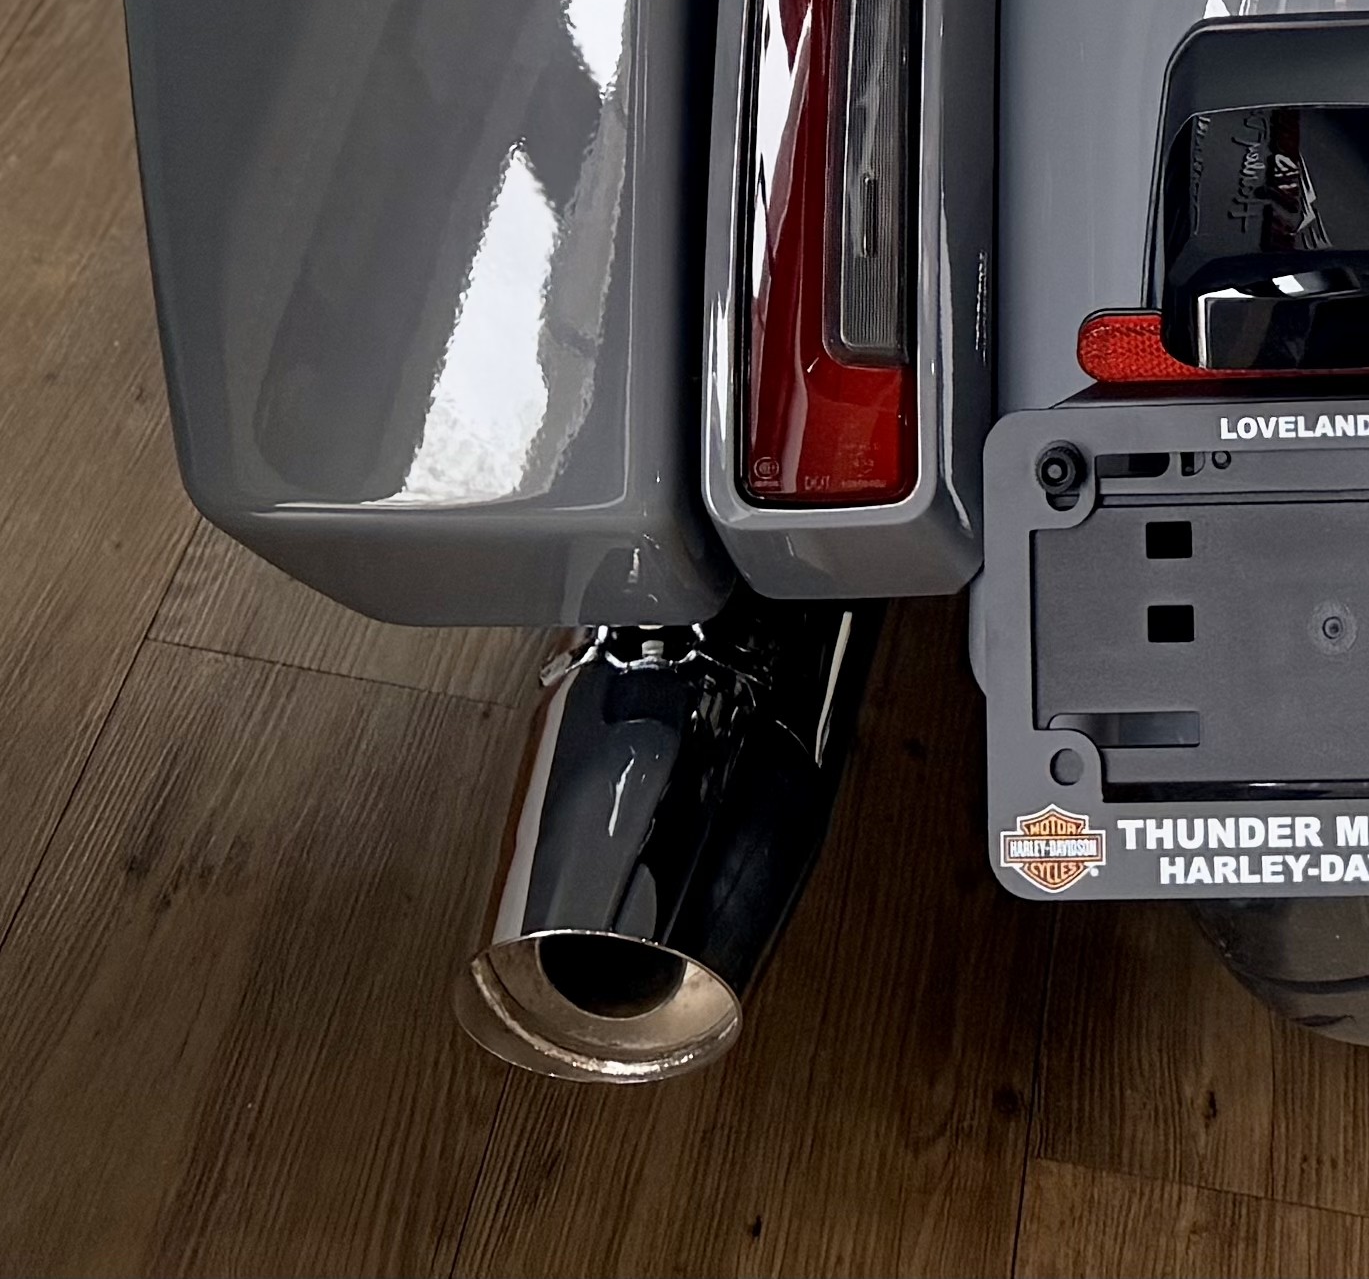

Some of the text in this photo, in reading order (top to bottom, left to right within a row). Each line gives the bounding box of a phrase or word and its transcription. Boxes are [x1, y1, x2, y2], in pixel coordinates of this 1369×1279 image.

[1029, 816, 1077, 836] MOTOR
[1116, 816, 1324, 851] THUNDER
[1030, 861, 1078, 884] CYCLES
